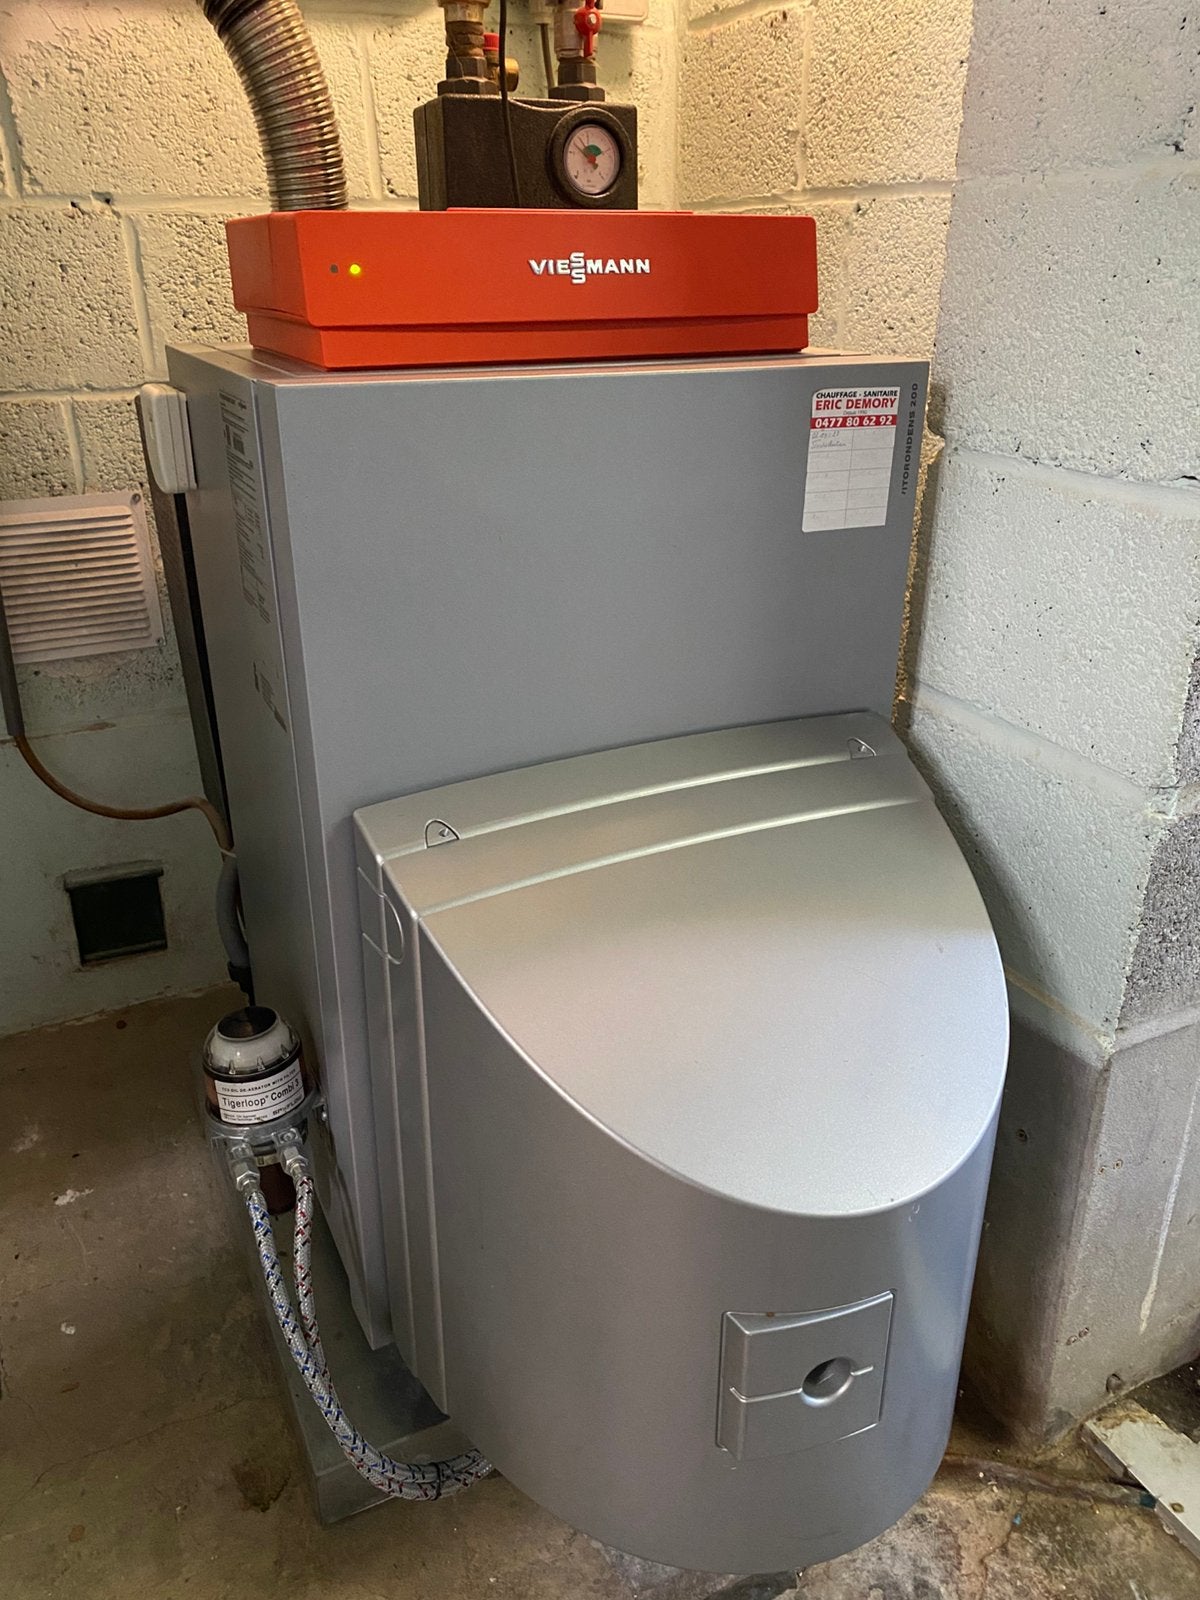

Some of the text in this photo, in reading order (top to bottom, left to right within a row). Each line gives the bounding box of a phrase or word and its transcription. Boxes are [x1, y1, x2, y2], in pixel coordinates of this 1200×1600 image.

[528, 252, 650, 284] VIESSMANN
[816, 391, 857, 399] CHAUFFAGE
[863, 390, 898, 398] SANITAIRE
[910, 383, 918, 407] 200
[815, 397, 897, 411] ERIC DEMORY
[815, 415, 893, 428] 0477 80 62 92
[270, 1082, 295, 1101] Combi
